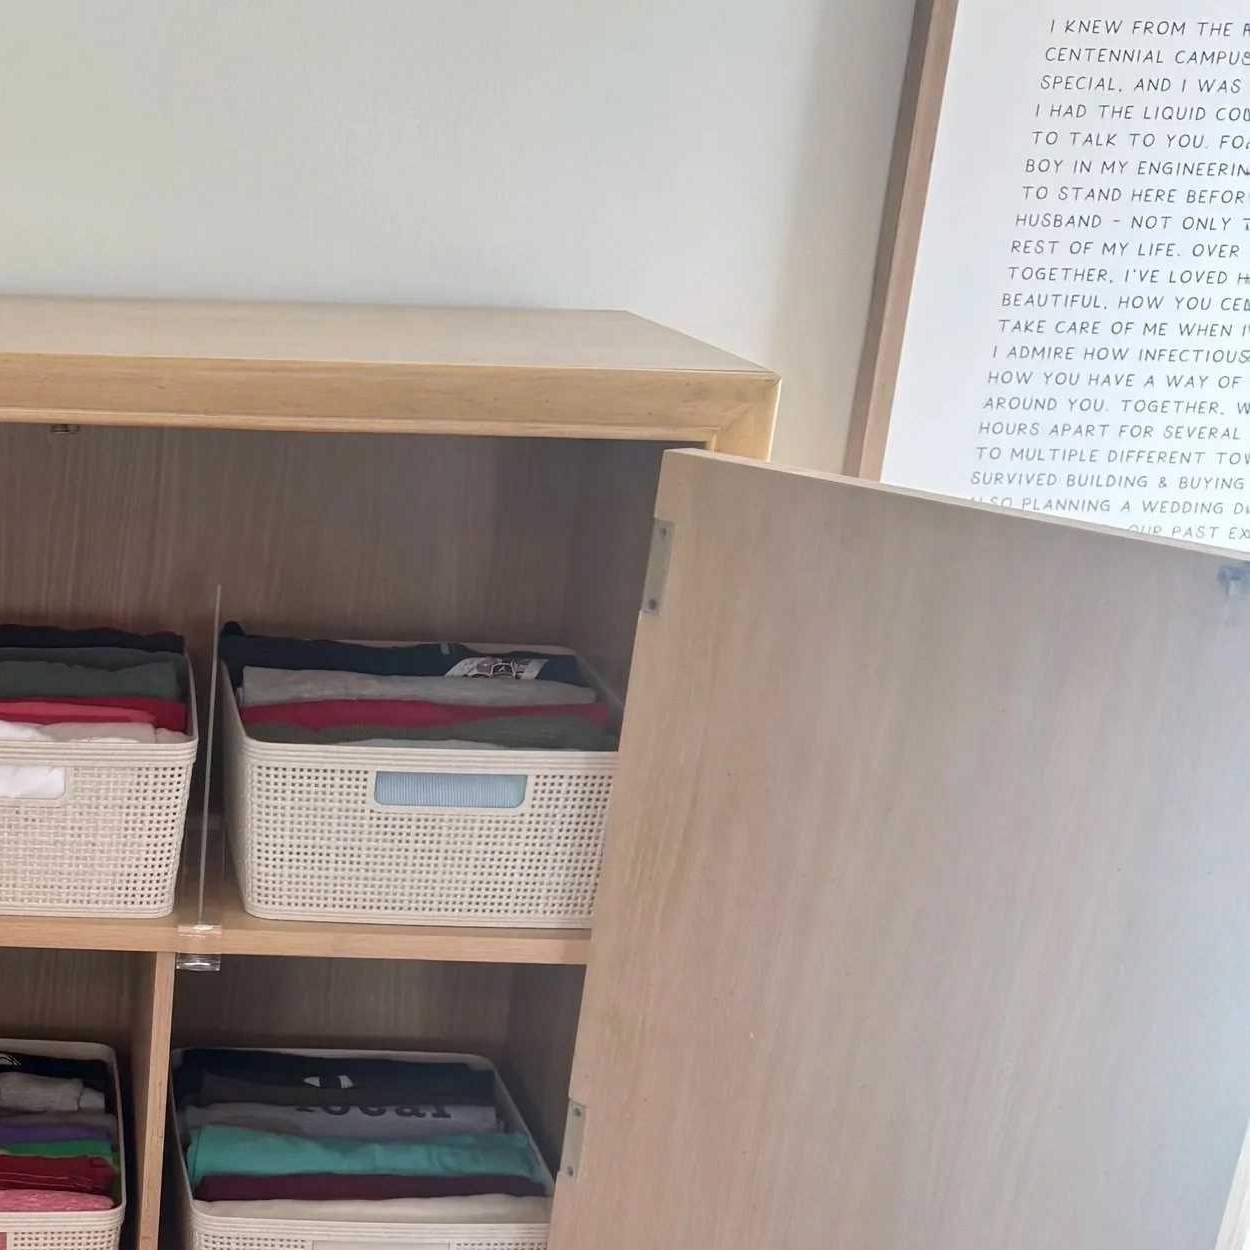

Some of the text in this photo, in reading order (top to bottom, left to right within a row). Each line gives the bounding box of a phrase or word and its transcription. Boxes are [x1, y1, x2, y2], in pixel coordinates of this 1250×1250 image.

[1050, 18, 1056, 34] I
[1064, 19, 1124, 35] KNEW
[1131, 20, 1187, 37] FROM
[1197, 21, 1234, 38] THE
[1045, 46, 1164, 64] CENTENNIAL
[1133, 77, 1172, 92] AND
[1181, 78, 1187, 94] I
[1197, 78, 1242, 95] WAS
[1035, 103, 1041, 118] I
[1049, 103, 1087, 119] HAD
[1097, 104, 1135, 120] THE
[1143, 105, 1207, 121] LIQUID
[1031, 130, 1059, 146] TO
[1069, 131, 1118, 148] TALK
[1128, 132, 1156, 148] TO
[1024, 158, 1064, 174] BOY
[1073, 159, 1093, 174] IN
[1100, 159, 1129, 175] MY
[1022, 185, 1250, 205] TO STAND HERE BEFOR
[1015, 212, 1103, 229] HUSBAND
[1130, 215, 1173, 230] NOT
[1181, 215, 1232, 232] ONLY
[1010, 239, 1060, 255] REST
[1069, 240, 1094, 256] OF
[1101, 241, 1130, 257] MY
[1191, 243, 1240, 259] OVER
[1124, 268, 1160, 284] I'VE
[1168, 269, 1228, 285] LOVED
[1117, 295, 1165, 310] HOW
[1174, 295, 1212, 311] YOU
[997, 318, 1047, 335] TAKE
[1054, 320, 1102, 335] CARE
[1110, 320, 1135, 336] OF
[1142, 322, 1169, 337] ME
[1178, 322, 1233, 338] WHEN
[992, 344, 998, 359] I
[1006, 345, 1076, 361] ADMIRE
[1083, 346, 1130, 361] HOW
[987, 370, 1243, 390] HOW YOU HAVE A WAY OF
[981, 396, 1058, 412] AROUND
[978, 420, 1241, 441] HOURS APART FOR SEVERAL
[976, 446, 1002, 461] TO
[1009, 447, 1100, 463] MULTIPLE
[1107, 449, 1207, 465] DIFFERENT
[970, 470, 1058, 487] SURVIVED
[1065, 473, 1148, 489] BUILDING
[1178, 475, 1245, 491] BUYING
[1021, 497, 1112, 513] PLANNING
[1119, 499, 1131, 513] A
[1141, 499, 1224, 515] WEDDING
[1171, 524, 1221, 540] PAST
